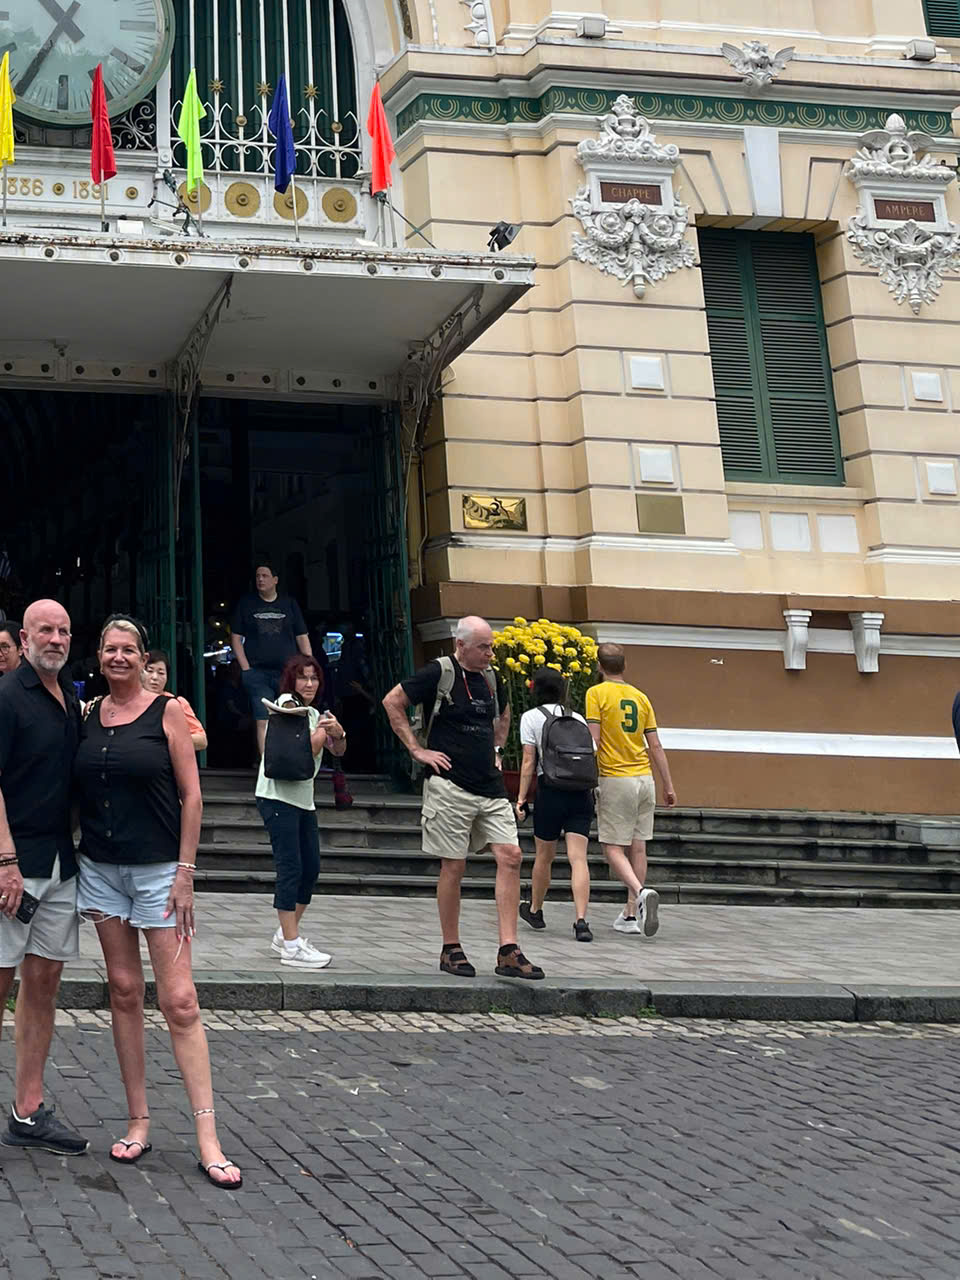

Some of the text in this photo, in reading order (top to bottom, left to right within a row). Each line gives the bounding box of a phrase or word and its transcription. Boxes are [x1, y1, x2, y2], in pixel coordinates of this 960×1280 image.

[1, 177, 109, 200] 886 1891
[620, 699, 639, 733] 3
